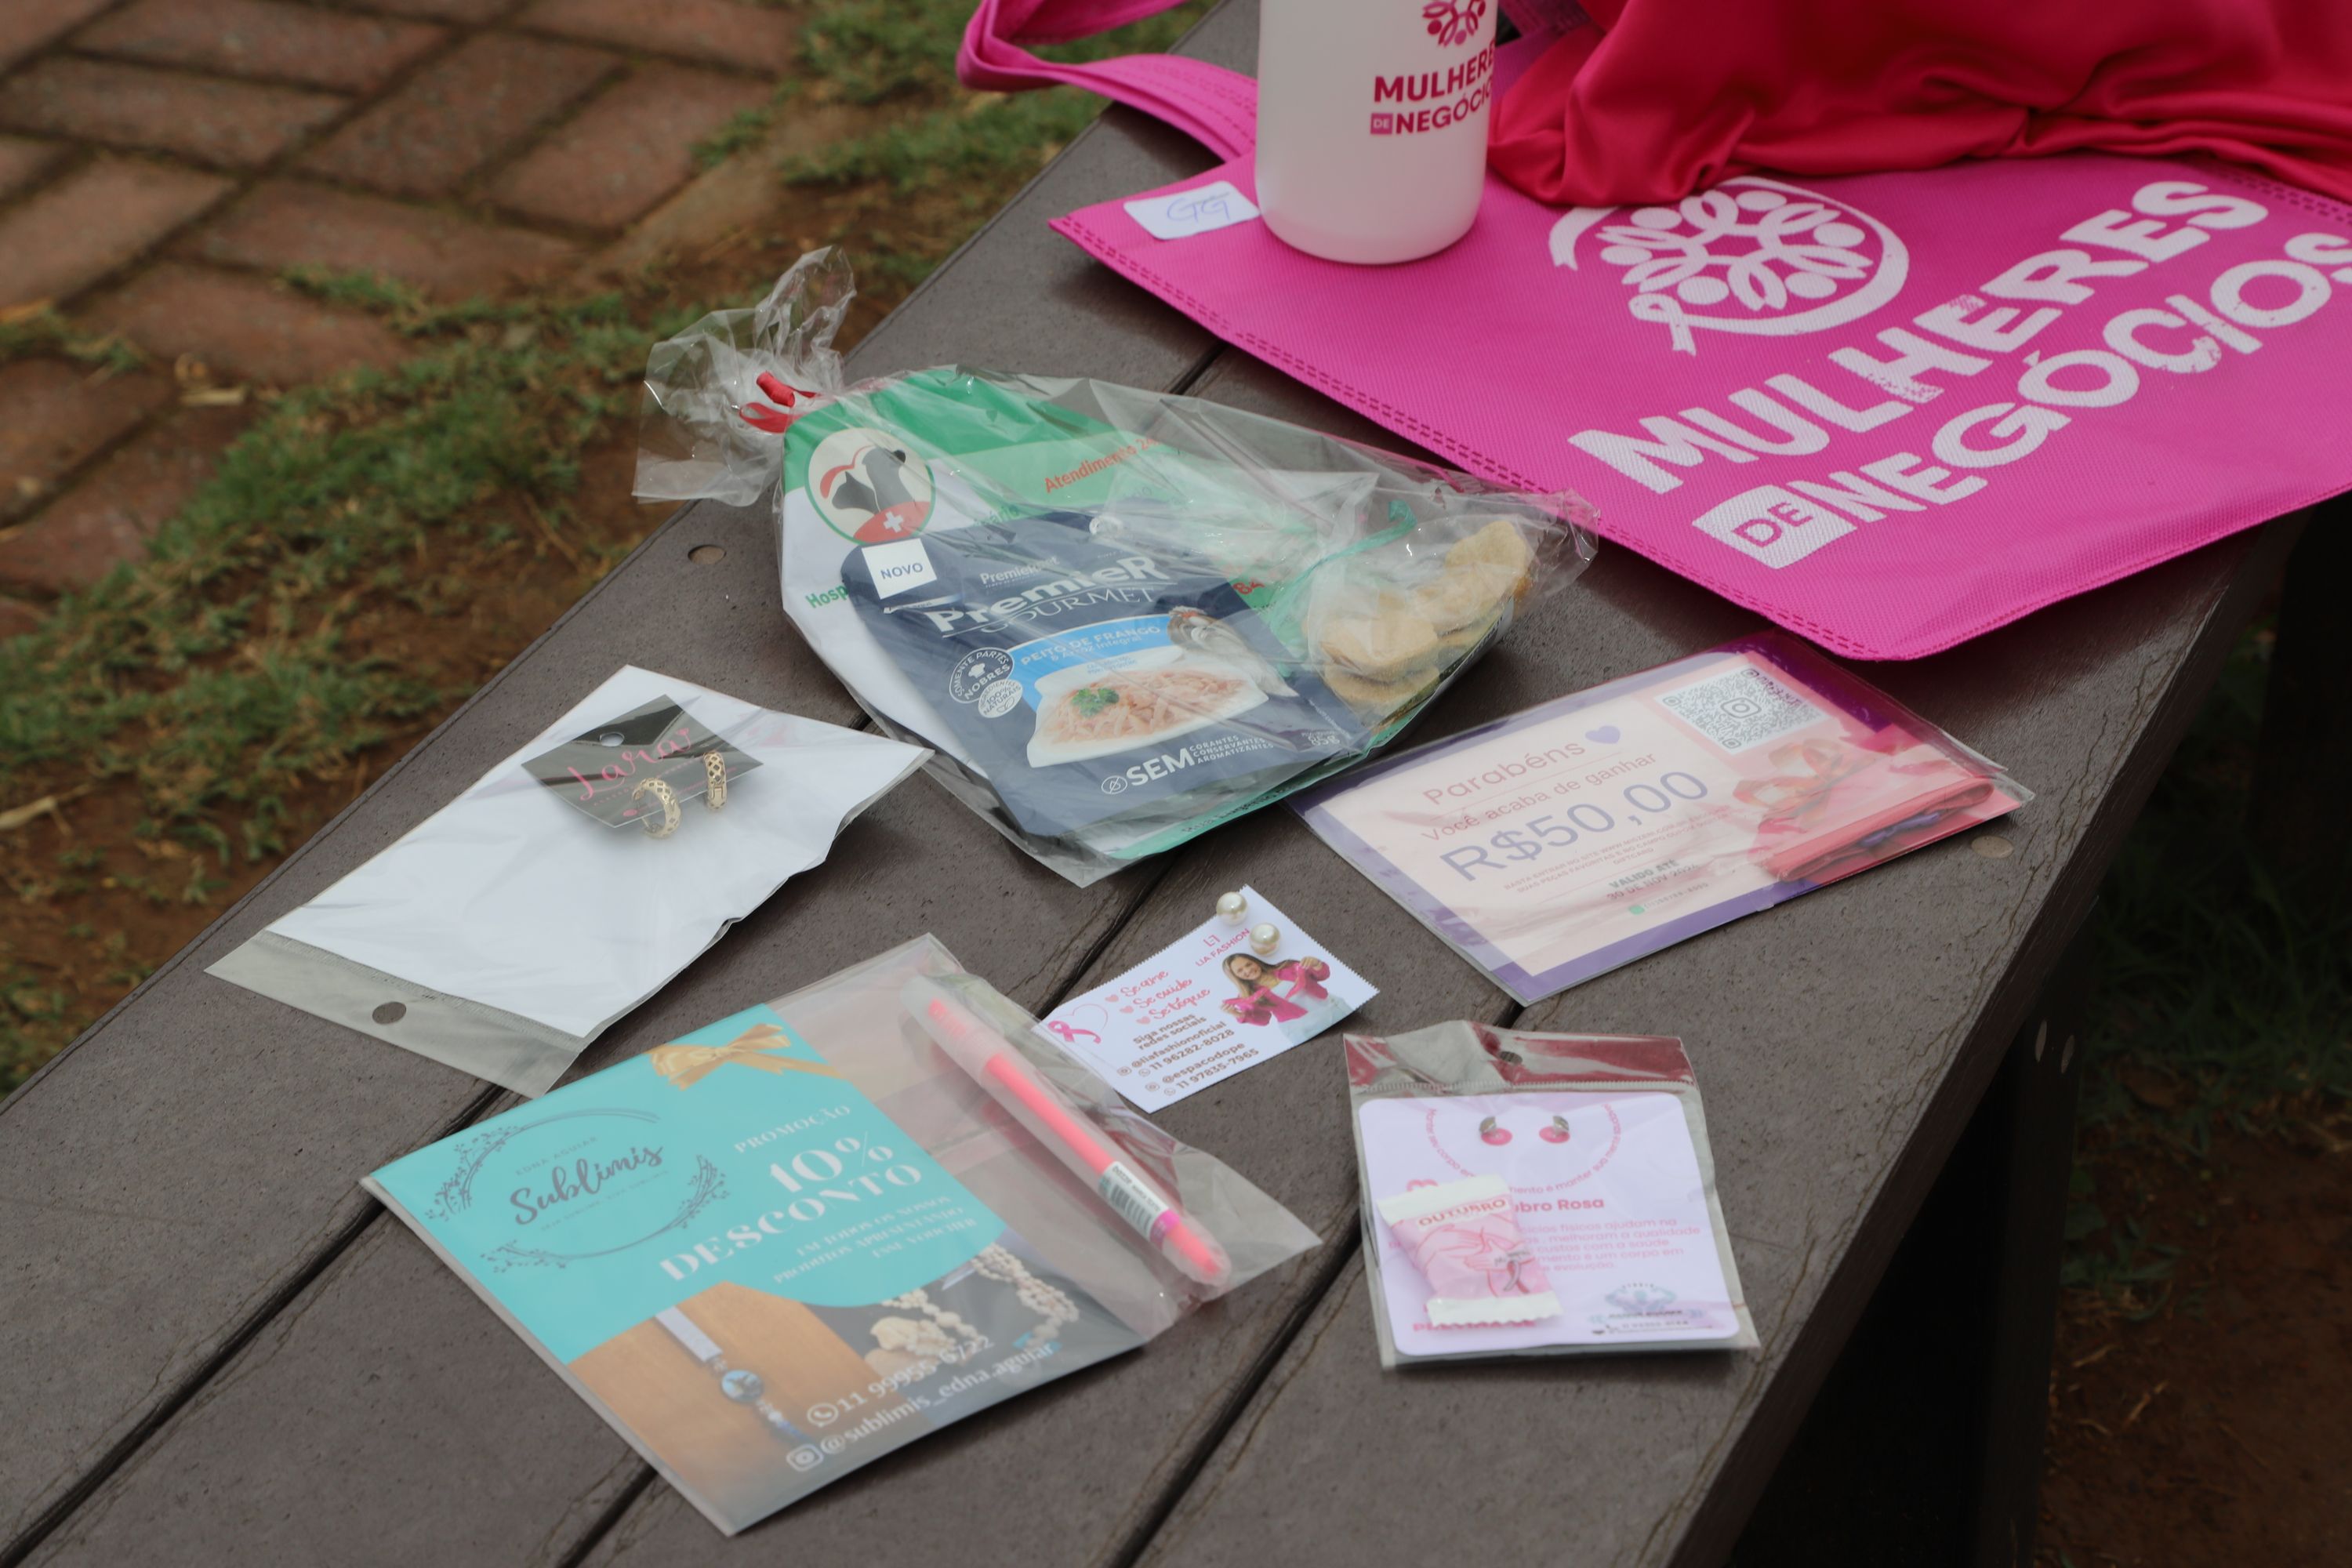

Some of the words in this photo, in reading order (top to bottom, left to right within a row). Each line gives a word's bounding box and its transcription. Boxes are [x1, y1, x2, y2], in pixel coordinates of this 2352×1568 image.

[1374, 38, 1495, 103] MULHERE
[1373, 118, 1391, 129] DE
[1567, 180, 2268, 495] MULHERES
[1044, 445, 1138, 493] Atendimento
[1731, 499, 1813, 549] DE
[880, 563, 924, 579] NOVO
[805, 584, 848, 608] Hosp
[1021, 645, 1067, 665] PEITO
[1069, 637, 1092, 648] DE
[1093, 626, 1161, 643] FRANGO
[1098, 636, 1142, 649] Integral
[954, 656, 975, 697] SOMENTE
[976, 651, 1009, 665] PARTES
[964, 664, 1011, 699] NOBRES
[1189, 735, 1239, 751] CORANTES
[1192, 738, 1266, 757] CONSERVANTES
[1197, 742, 1274, 764] AROMATIZANTES
[1126, 748, 1196, 786] SEM
[1423, 742, 1585, 805] Parabéns
[1421, 815, 1480, 841] Você
[1485, 791, 1551, 820] acaba
[1554, 779, 1581, 795] de
[1585, 753, 1657, 786] ganhar
[1439, 771, 1708, 881] R$50,00
[1210, 927, 1250, 958] FASHION
[1120, 985, 1141, 997] Se
[1140, 971, 1168, 988] ame
[1133, 997, 1156, 1008] Se
[1156, 979, 1192, 1000] cuide
[1149, 1007, 1171, 1019] Se
[1159, 1014, 1196, 1033] nossas
[1138, 1033, 1169, 1050] redes
[1170, 1016, 1207, 1035] sociais
[1149, 1062, 1163, 1070] 11
[1162, 1043, 1245, 1083] @espacodope
[1176, 1080, 1189, 1089] 11
[733, 1105, 851, 1154] PROMOÇÃO
[769, 1131, 894, 1193] 10%
[510, 1146, 663, 1225] Sublimis
[1555, 1171, 1592, 1191] manter
[1418, 1199, 1506, 1226] OUTUBRO
[1557, 1198, 1604, 1210] Rosa
[660, 1164, 922, 1281] DESCONTO
[1548, 1232, 1618, 1243] melhoram
[1633, 1226, 1700, 1240] qualidade
[1605, 1218, 1656, 1231] ajudam
[1659, 1218, 1677, 1227] na
[821, 1342, 1055, 1454] @sublimis_edna.aguiar
[837, 1392, 867, 1412] 11
